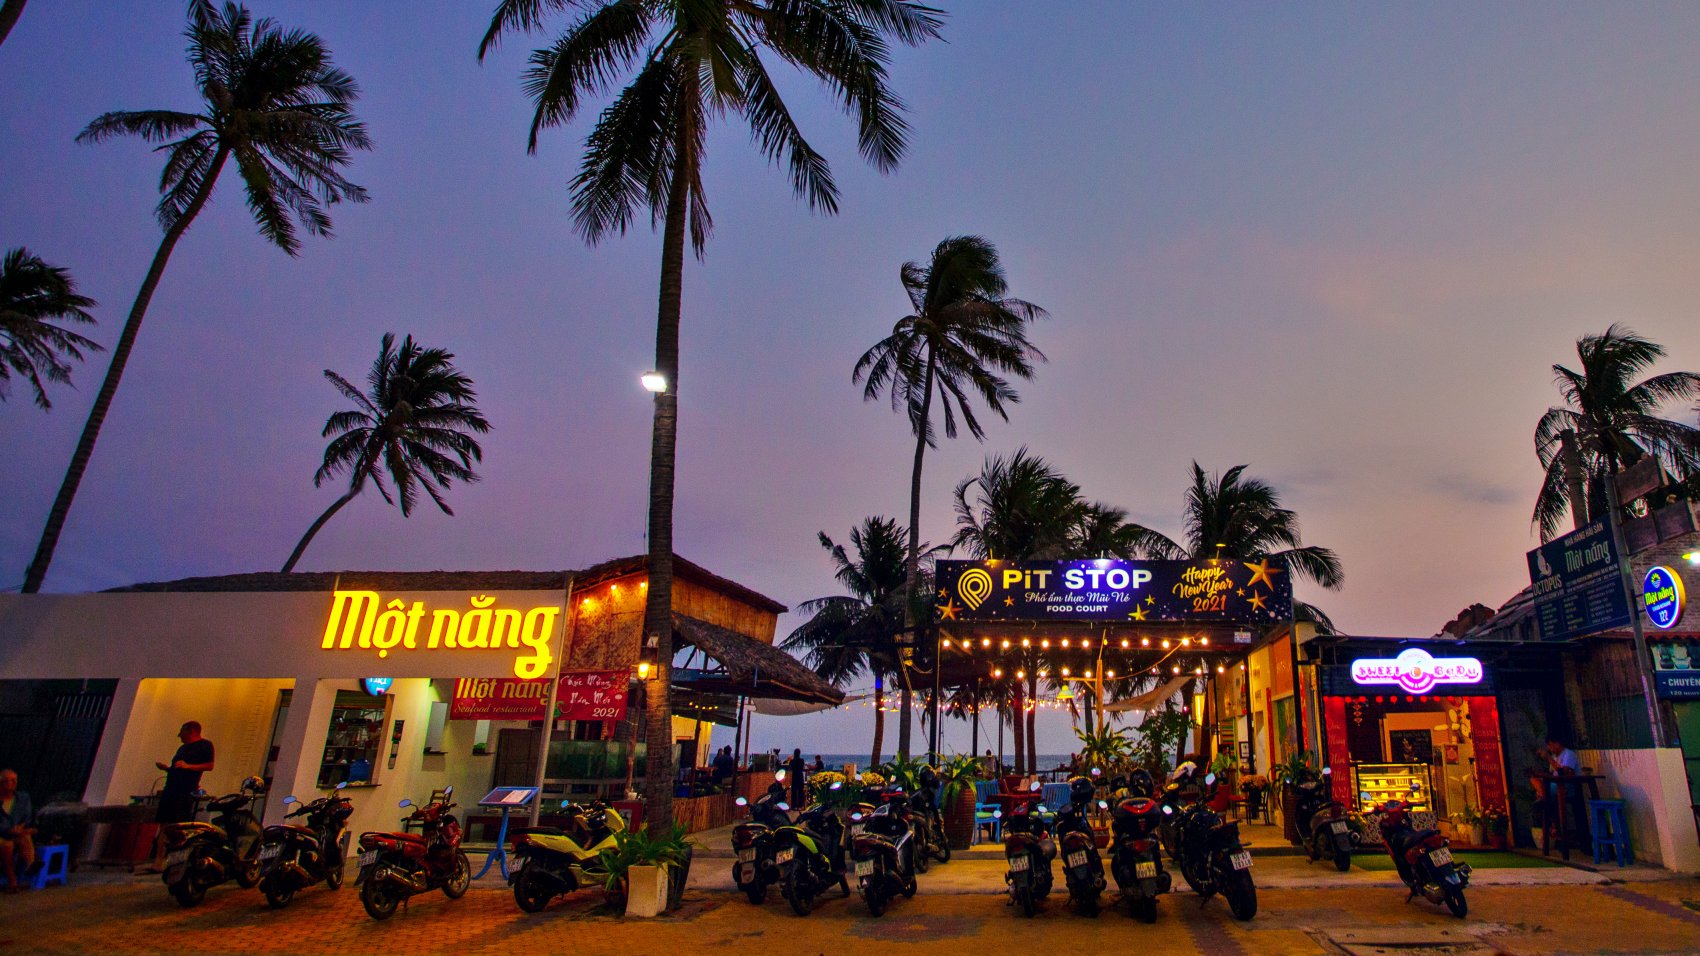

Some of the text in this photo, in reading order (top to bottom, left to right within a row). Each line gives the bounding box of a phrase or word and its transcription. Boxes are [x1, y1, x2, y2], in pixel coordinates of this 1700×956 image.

[1564, 541, 1611, 573] Một nắng
[1002, 569, 1153, 589] PiT STOP
[1181, 566, 1226, 584] Happy
[1532, 573, 1563, 597] OCTOPUS
[1025, 591, 1048, 603] Phố
[1064, 591, 1085, 604] thực
[1087, 591, 1110, 603] Mũi
[1111, 591, 1131, 603] Né
[1192, 594, 1227, 613] 2021
[1644, 586, 1675, 606] Một nắng
[322, 590, 560, 680] Một nắng
[1359, 666, 1400, 676] SWEET
[456, 678, 498, 702] Một
[454, 702, 537, 716] Seafood restaurant
[592, 707, 620, 718] 2021
